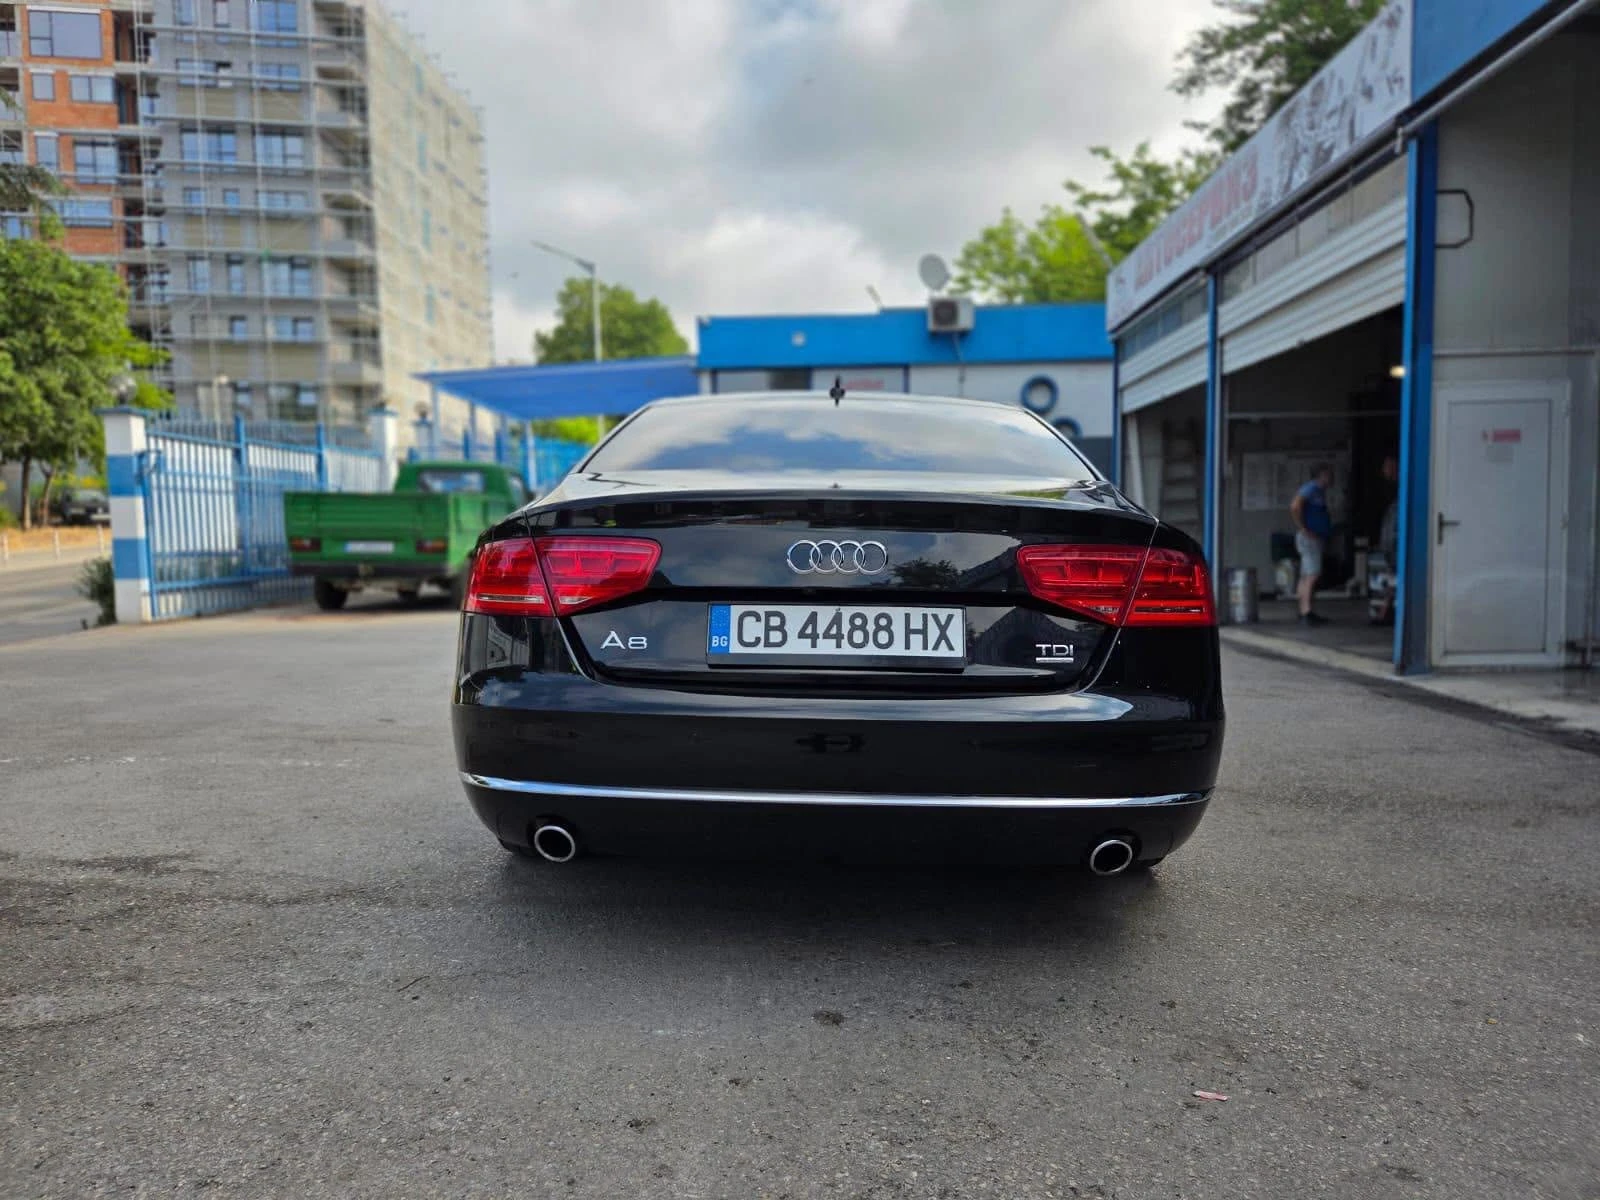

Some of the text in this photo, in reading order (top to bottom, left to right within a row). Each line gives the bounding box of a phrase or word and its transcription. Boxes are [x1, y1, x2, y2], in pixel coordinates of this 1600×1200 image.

[600, 630, 648, 650] A8
[711, 609, 956, 652] BG CB 4488 HX
[1035, 644, 1074, 656] TDI
